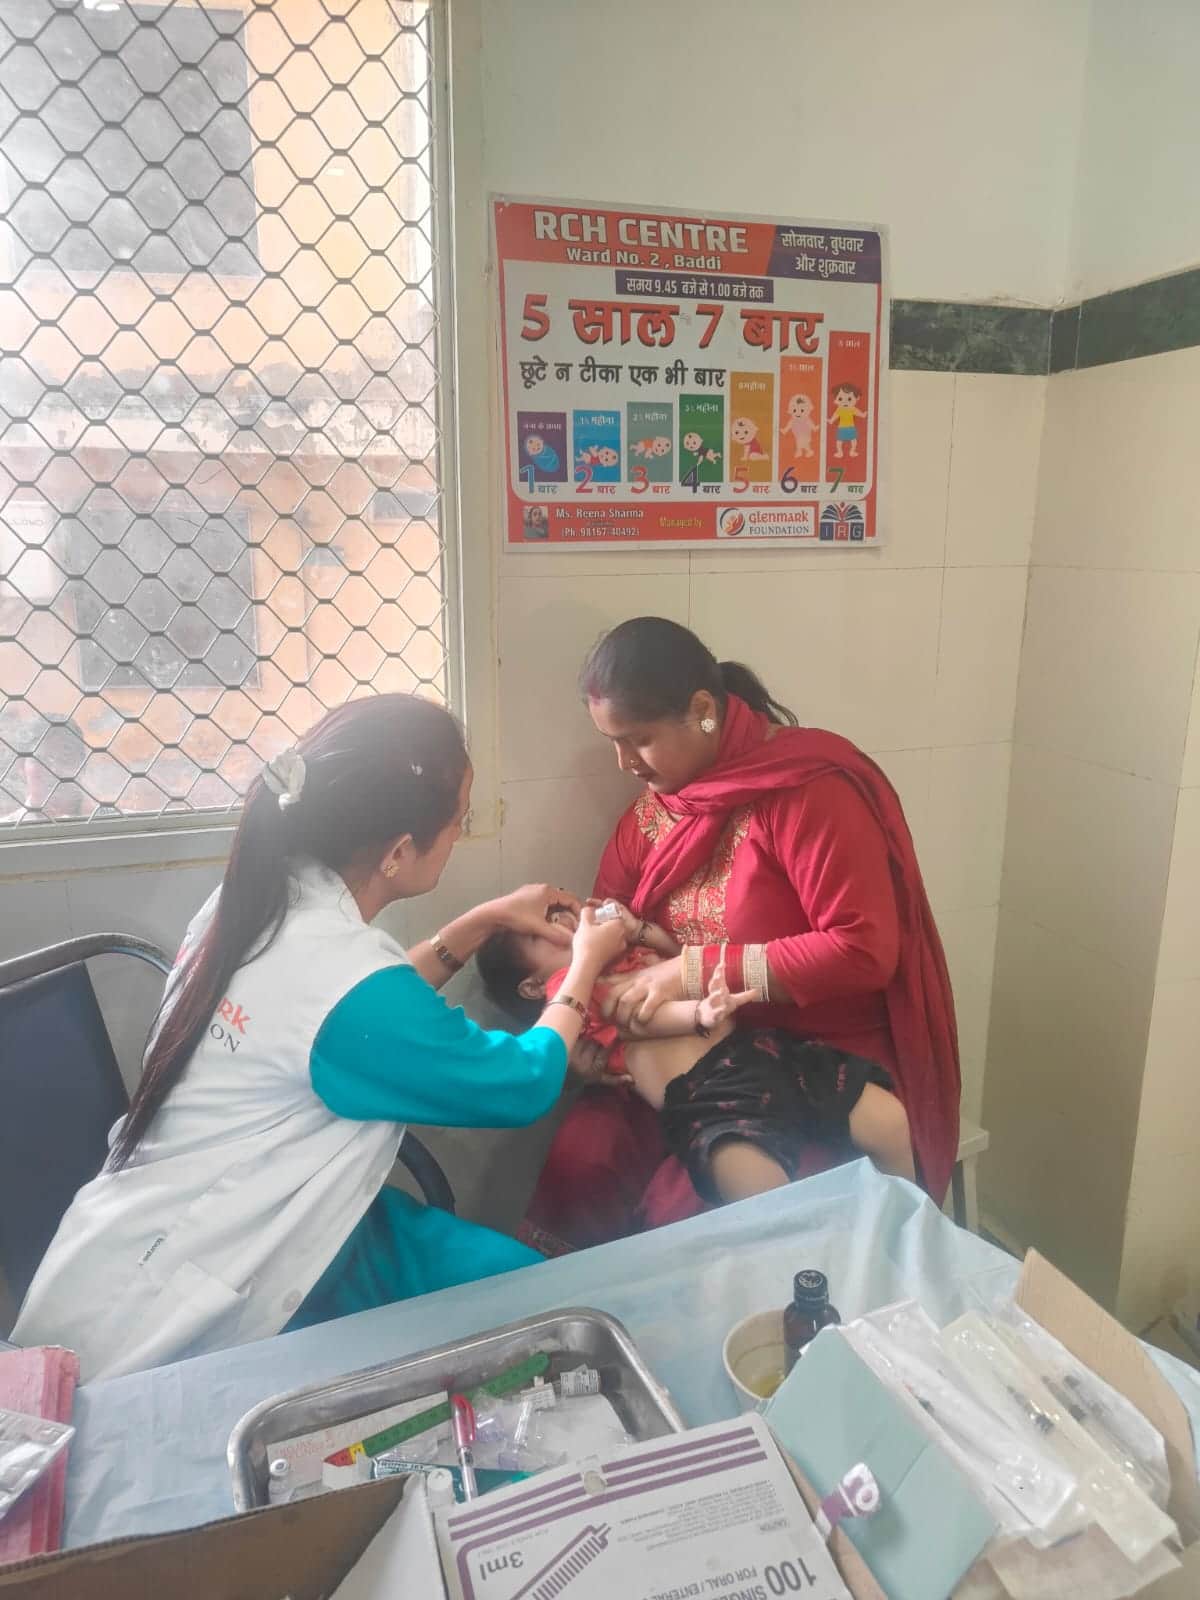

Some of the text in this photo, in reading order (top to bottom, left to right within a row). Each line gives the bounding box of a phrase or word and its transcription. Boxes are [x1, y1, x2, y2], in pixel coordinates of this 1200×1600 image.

[534, 211, 748, 253] RCH CENTRE
[781, 230, 864, 255] सोमवार, बुधवार
[567, 248, 611, 263] Ward
[617, 251, 644, 265] No.
[651, 254, 660, 266] 2
[675, 254, 721, 269] Baddi
[795, 253, 856, 278] और शुक्रवार
[626, 278, 652, 293] समय
[655, 280, 677, 294] 9.45
[711, 283, 730, 297] 1.00
[748, 286, 765, 299] तक
[521, 294, 824, 354] 5 साल 7 बार
[520, 355, 726, 389] छूटे न टीका एक भी बार
[520, 465, 535, 494] 1
[575, 466, 593, 494] 2
[631, 466, 649, 494] 3
[680, 465, 700, 494] 4
[733, 467, 750, 494] 5
[781, 467, 798, 494] 6
[828, 467, 845, 494] 7
[576, 509, 605, 518] Reena
[609, 509, 644, 518] Sharma
[750, 526, 810, 536] FOUNDATION
[480, 1551, 523, 1581] 3ml
[736, 1566, 757, 1582] FOR
[764, 1557, 816, 1596] 100
[705, 1572, 735, 1590] ORAL
